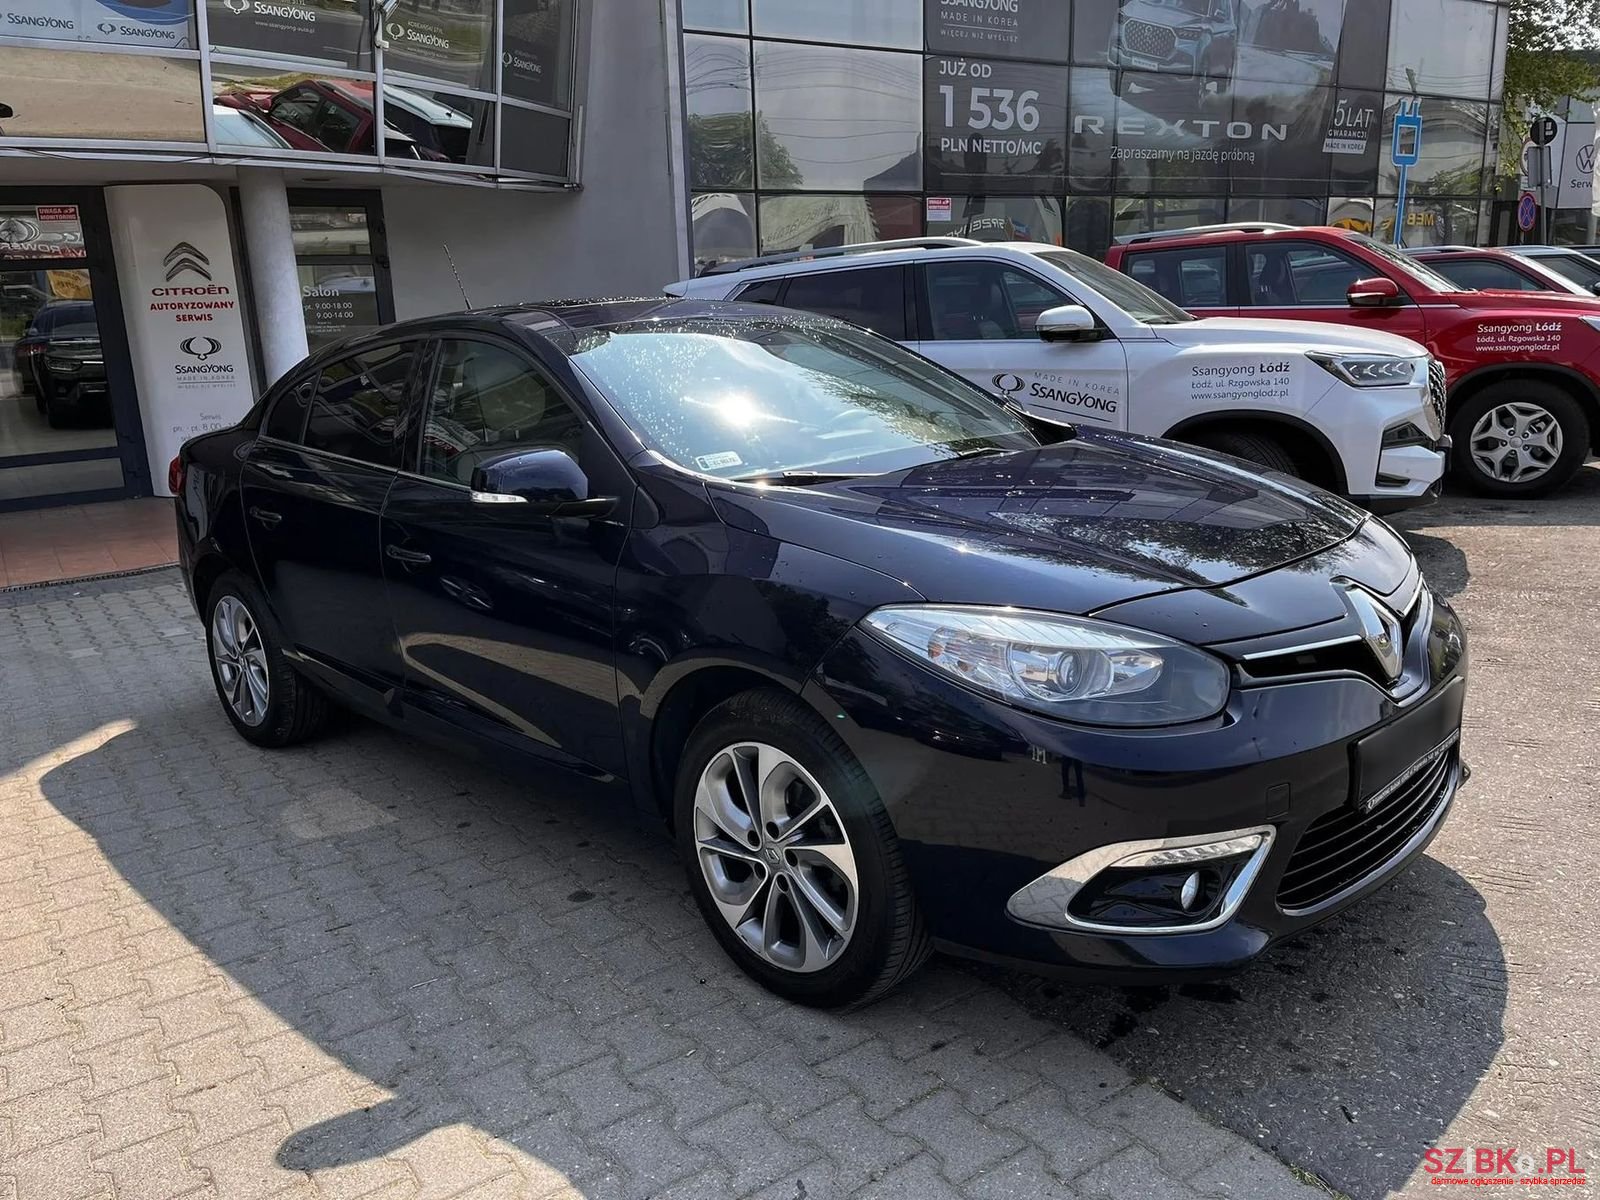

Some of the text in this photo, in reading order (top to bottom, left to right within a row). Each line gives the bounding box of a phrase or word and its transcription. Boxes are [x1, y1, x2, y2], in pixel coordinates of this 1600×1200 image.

[254, 1, 316, 22] SSANGYONG
[940, 11, 1018, 27] MADE IN KOREA
[7, 12, 74, 30] SSANGYONG
[119, 25, 175, 40] SSANGYONG
[939, 57, 992, 79] JUŻ OD
[1074, 115, 1288, 141] REXTON
[940, 137, 1042, 156] PLN NETTO/MC
[1110, 145, 1256, 165] Zapraszamy na jazdę próbną
[302, 284, 340, 297] Salon
[150, 301, 234, 311] AUTORYZOWANY
[175, 313, 213, 322] SERWIS
[1477, 322, 1562, 335] Ssangyong Łódź
[1508, 335, 1545, 343] Rzgowska
[1547, 334, 1561, 342] 140
[1475, 343, 1560, 352] www.ssangyonglodz.pl
[174, 364, 234, 374] SSANGYONG
[1192, 362, 1290, 377] Ssangyong Łódź
[1034, 371, 1120, 396] MADE IN KOREA
[1228, 379, 1271, 388] Rzgowska
[1273, 377, 1290, 386] 140
[1029, 382, 1118, 413] SSANGYONG
[1190, 388, 1289, 400] www.ssangyonglodz.pl
